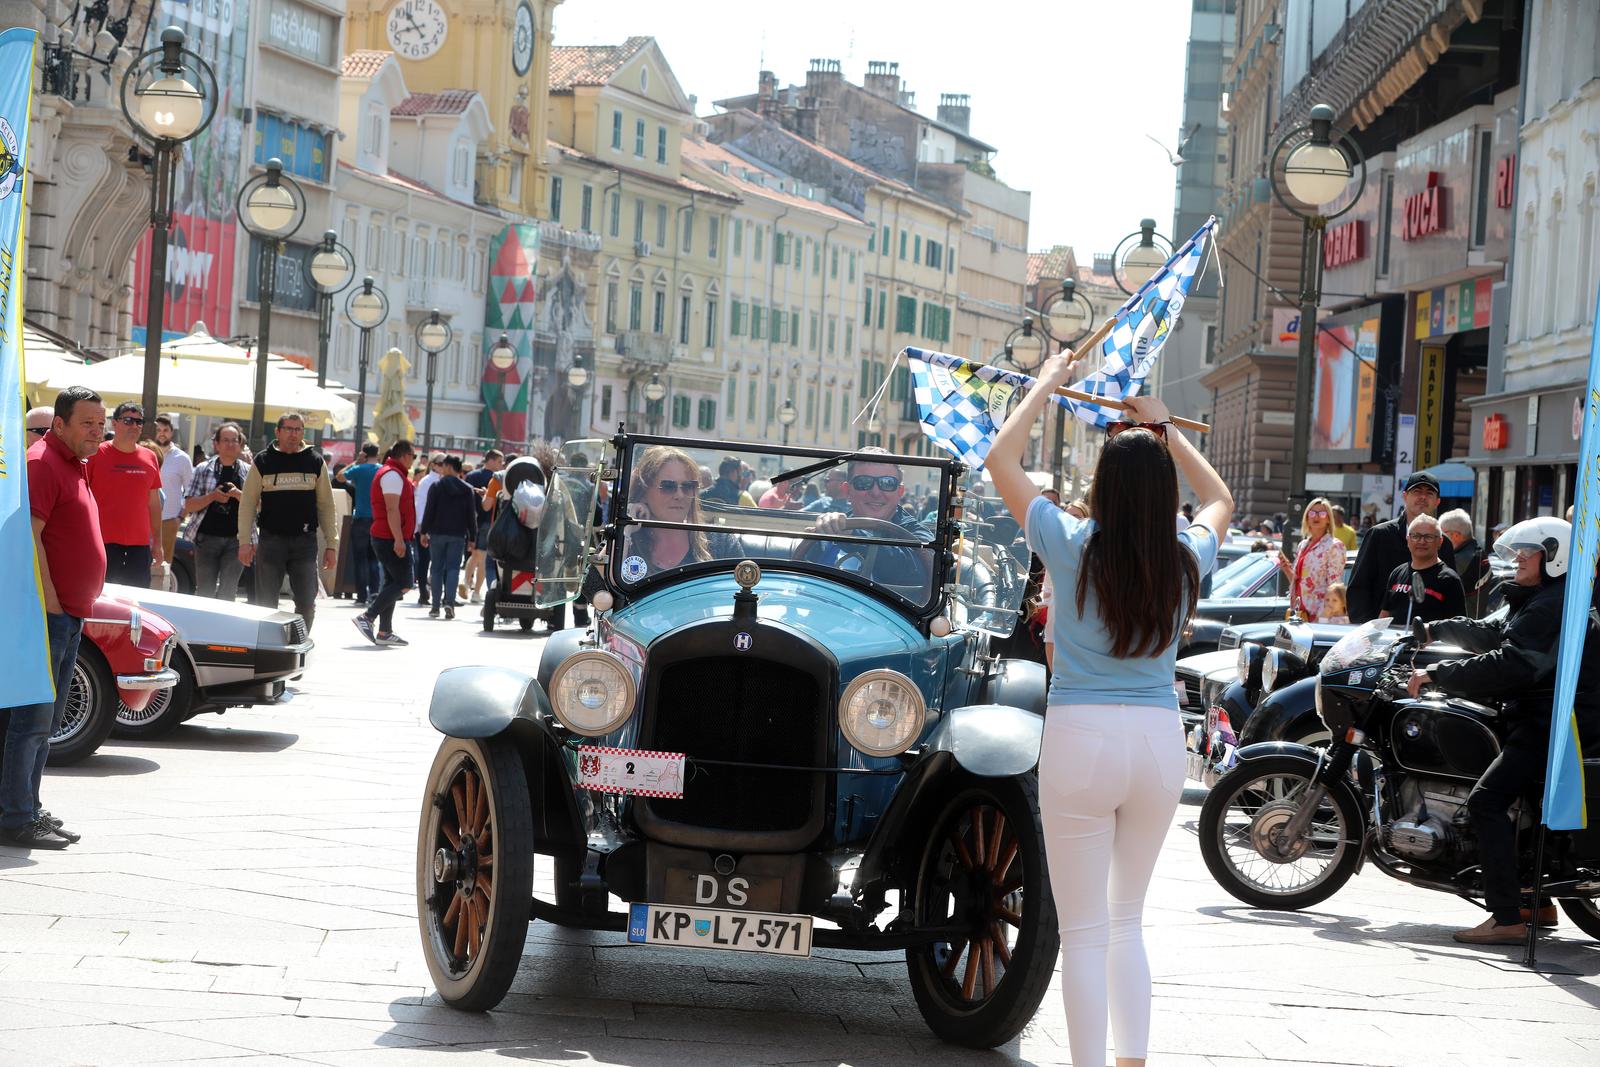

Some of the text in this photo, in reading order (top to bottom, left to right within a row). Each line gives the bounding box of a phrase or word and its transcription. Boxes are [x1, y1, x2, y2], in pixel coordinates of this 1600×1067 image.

[390, 20, 398, 32] 9
[437, 22, 444, 34] 3
[299, 19, 321, 53] dom
[403, 42, 410, 54] 7
[411, 44, 419, 57] 6
[422, 43, 429, 54] 5
[1325, 220, 1361, 270] OBNA
[1403, 171, 1444, 241] KUĆA
[1424, 353, 1436, 469] HAPPY HO
[1400, 451, 1411, 464] 2.
[1396, 584, 1412, 593] HU
[737, 634, 749, 649] H
[626, 761, 635, 774] 2
[632, 910, 802, 951] SLO KP L7-571
